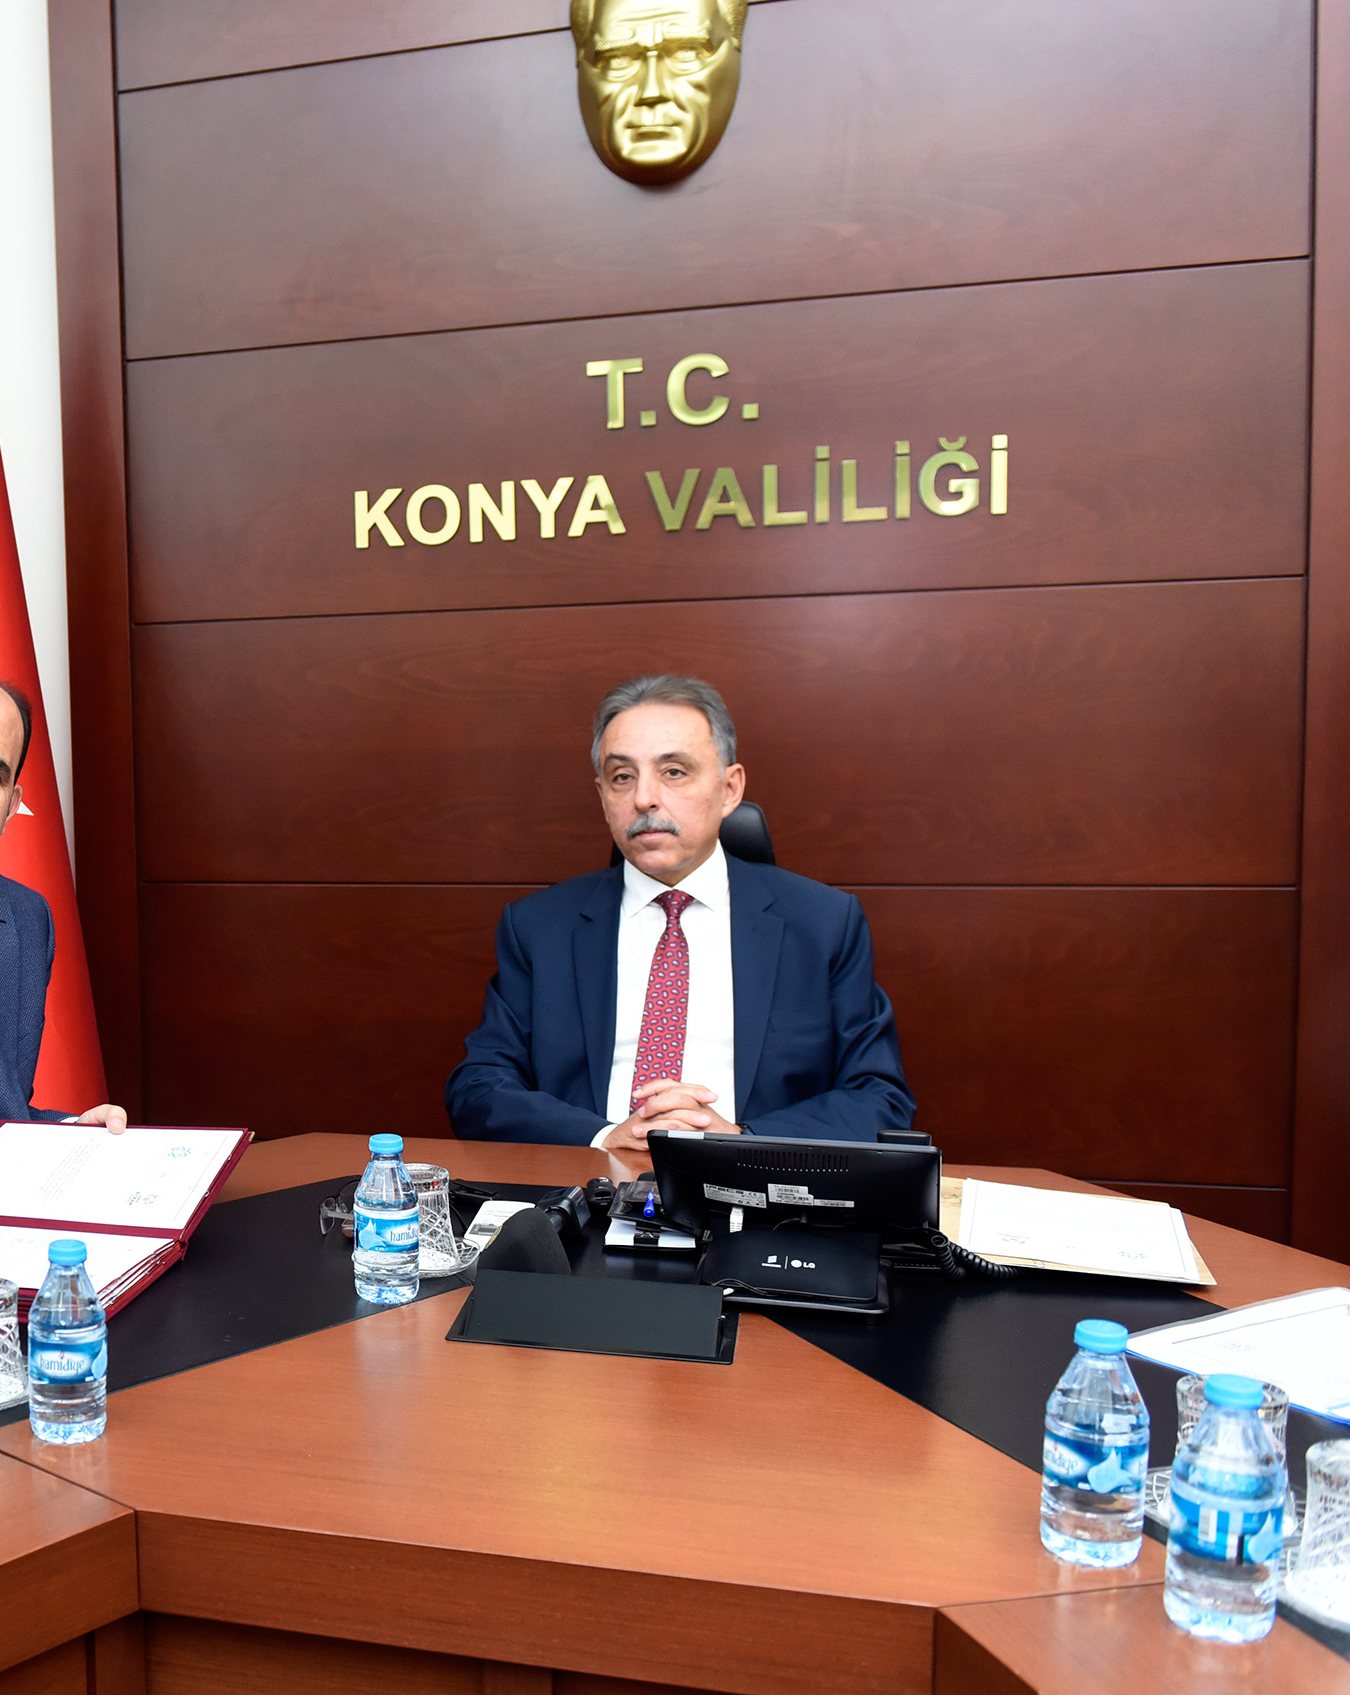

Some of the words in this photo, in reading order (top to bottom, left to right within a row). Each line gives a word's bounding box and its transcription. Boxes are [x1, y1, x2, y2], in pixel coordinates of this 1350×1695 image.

[585, 352, 760, 430] T.C.
[353, 474, 626, 549] KONYA
[644, 433, 1008, 531] VALİLİĞİ
